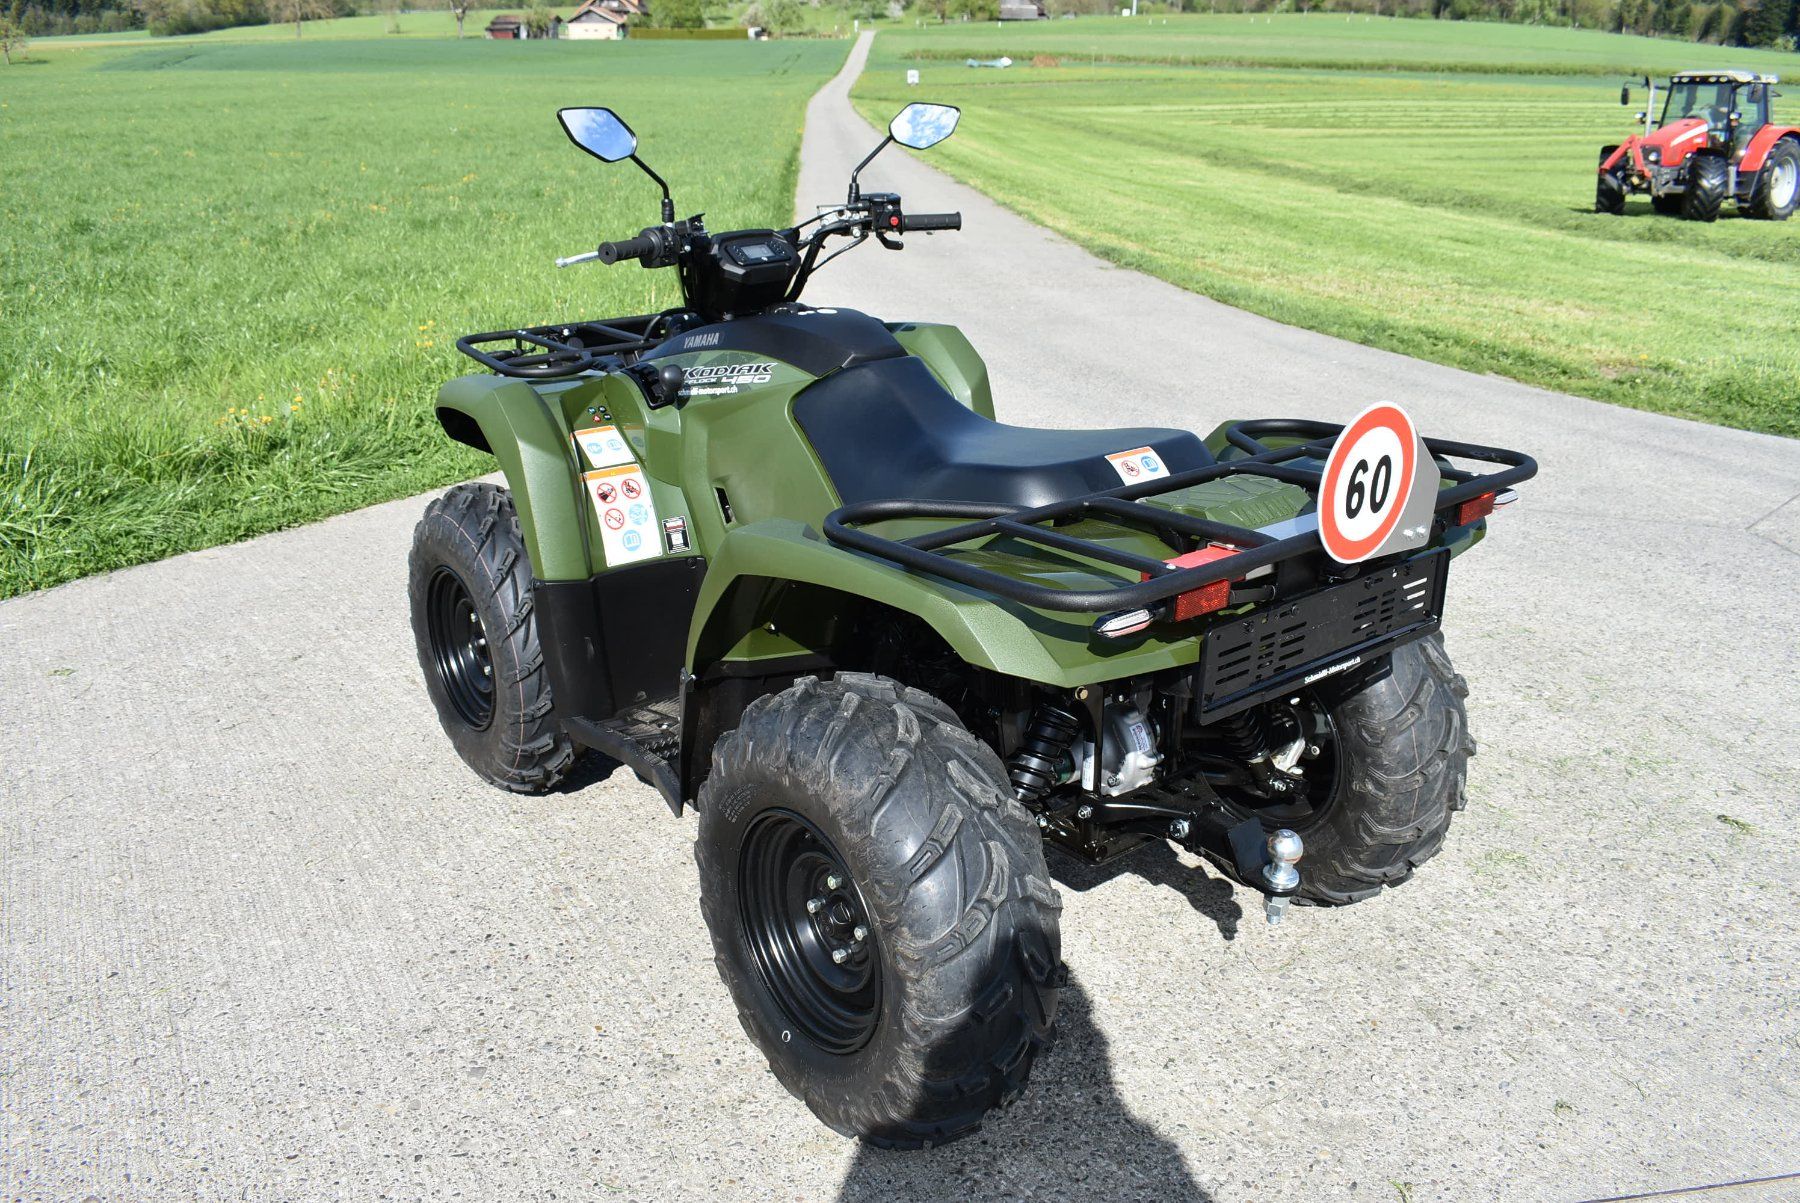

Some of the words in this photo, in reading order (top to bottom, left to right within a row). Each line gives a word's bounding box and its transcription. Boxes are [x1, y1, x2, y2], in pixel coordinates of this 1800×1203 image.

[684, 332, 720, 349] YAMAHA
[682, 362, 778, 380] KODIAK
[721, 374, 772, 385] 450
[1345, 454, 1392, 520] 60
